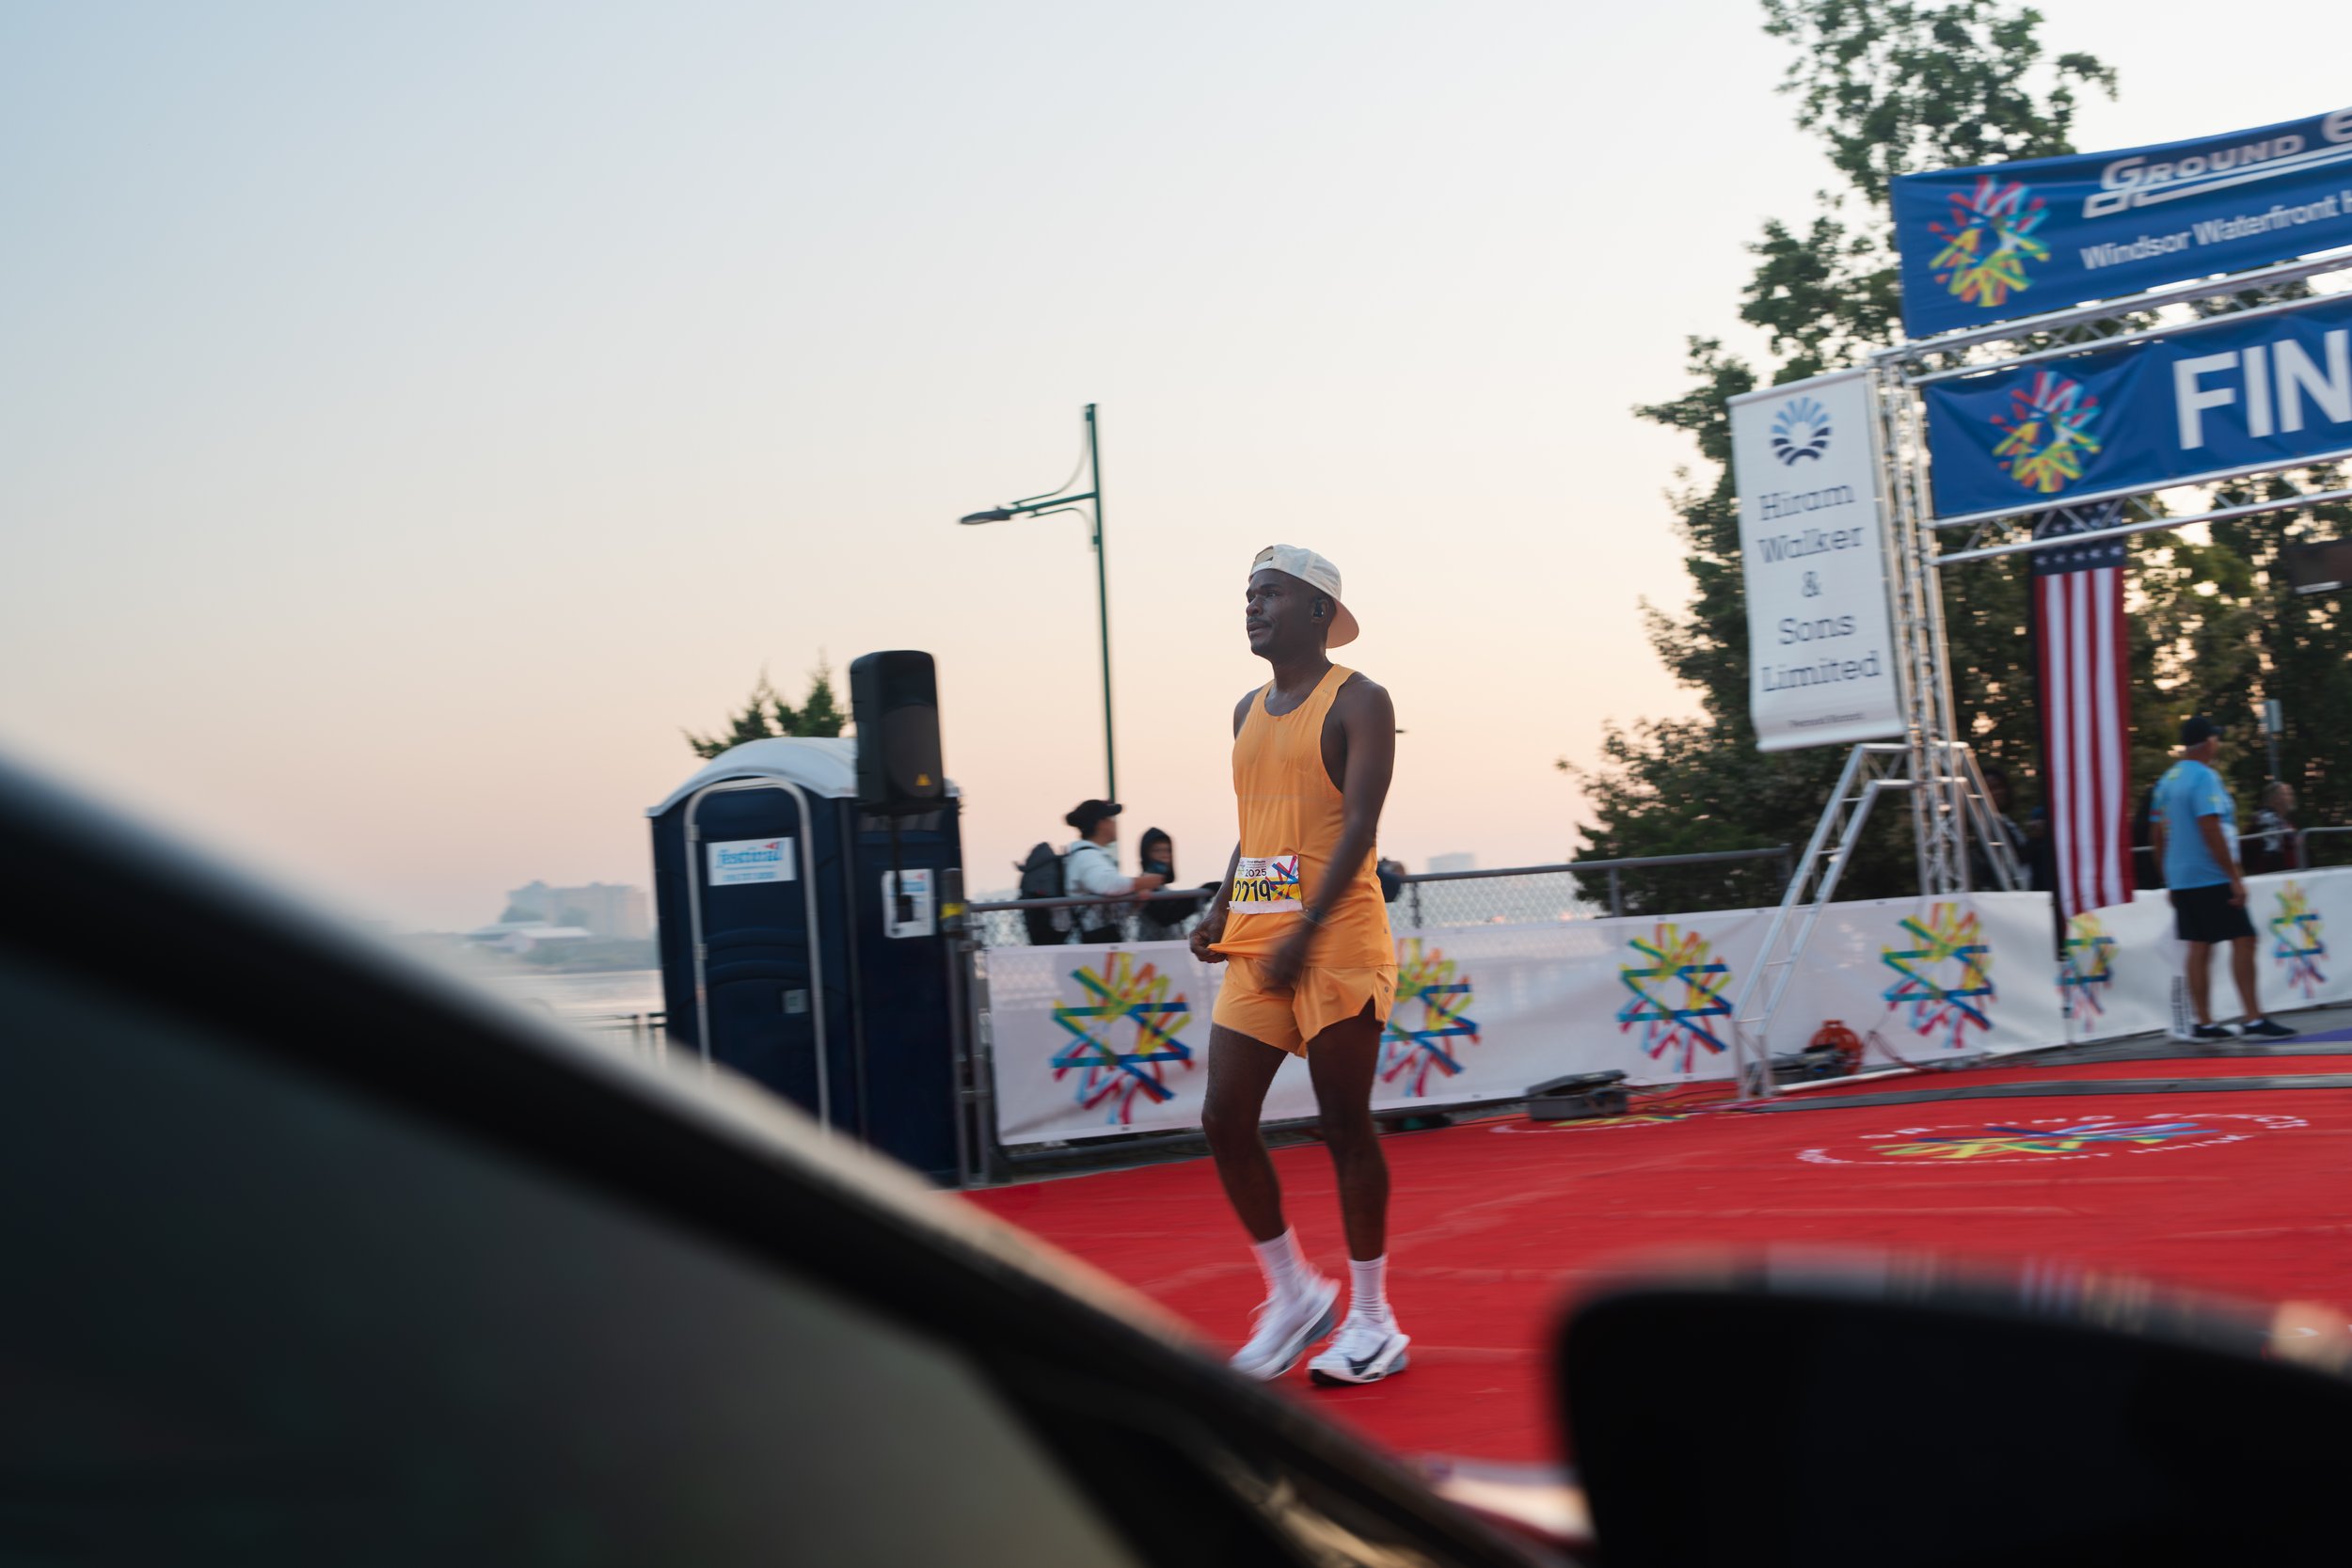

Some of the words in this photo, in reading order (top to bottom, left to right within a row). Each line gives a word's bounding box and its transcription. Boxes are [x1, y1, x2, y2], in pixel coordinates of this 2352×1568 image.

[2080, 231, 2192, 270] Windsor
[2191, 195, 2340, 246] Waterfront
[1758, 483, 1855, 521] Hiram
[1756, 527, 1865, 563] Walker
[1801, 570, 1822, 598] &
[1778, 614, 1856, 645] Sons
[1761, 650, 1882, 693] Limited
[1245, 867, 1267, 878] 2025
